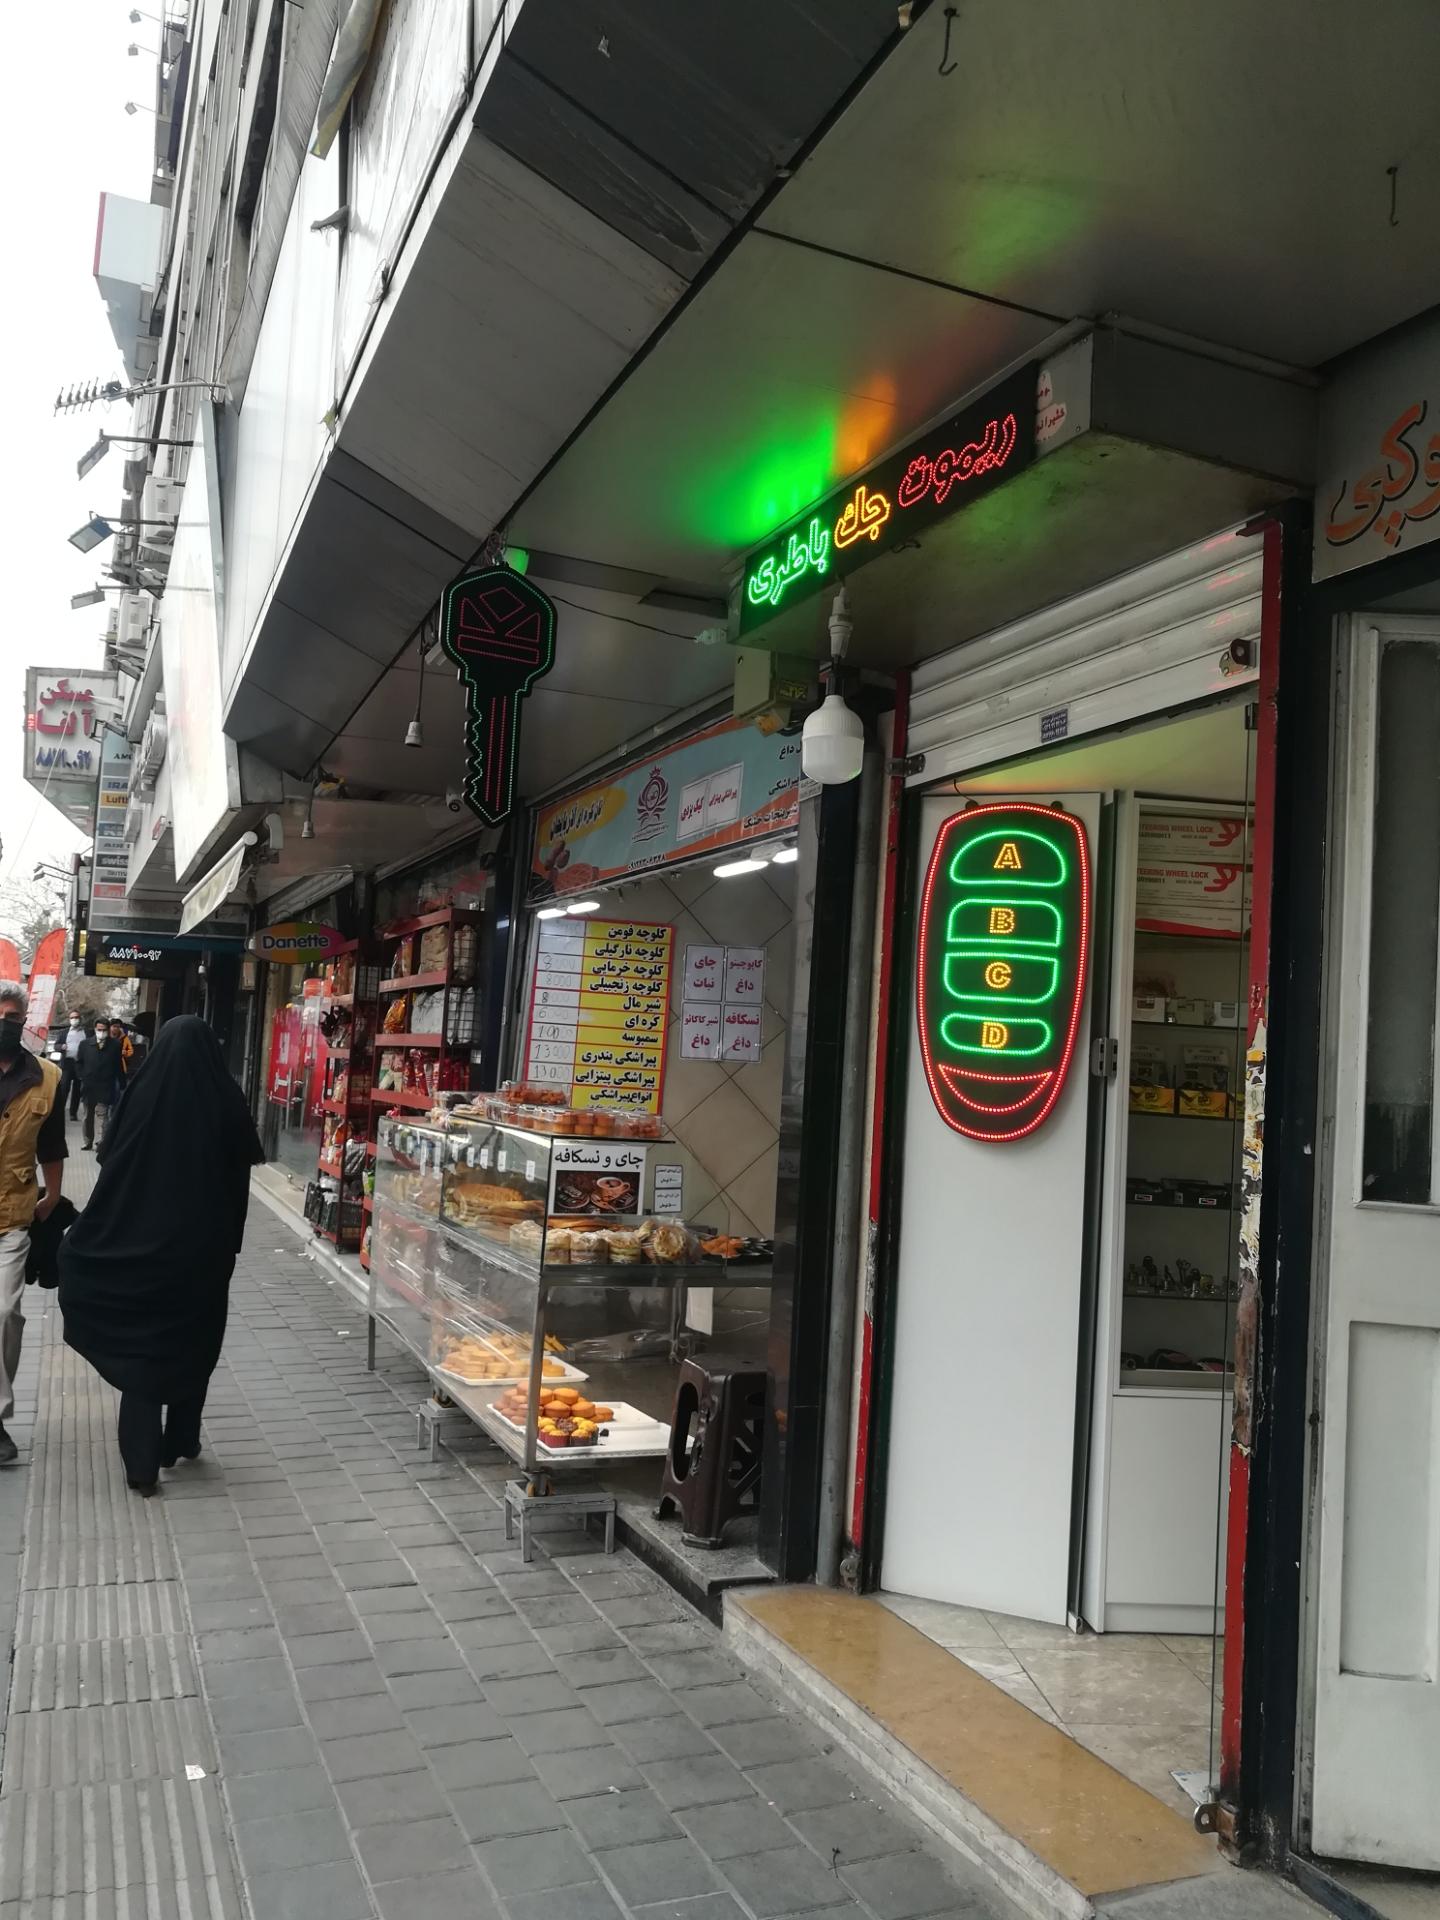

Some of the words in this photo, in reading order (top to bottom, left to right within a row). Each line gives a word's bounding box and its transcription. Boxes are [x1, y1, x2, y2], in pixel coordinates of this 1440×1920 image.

[899, 413, 1017, 508] ریموت
[748, 518, 829, 605] باطری
[36, 708, 96, 736] آلفا
[107, 782, 128, 790] IRA
[993, 843, 1022, 870] A
[1137, 867, 1164, 876] TEERING
[1166, 869, 1189, 877] WHEEL
[1191, 871, 1209, 879] LOCK
[989, 907, 1015, 934] B
[608, 925, 634, 939] فومن
[636, 928, 667, 942] کلوچه
[262, 935, 329, 950] Danette
[595, 942, 632, 959] نارگیلی
[634, 947, 665, 961] کلوچه
[592, 961, 631, 975] خرمایی
[633, 964, 664, 978] کلوچه
[984, 961, 1012, 988] C
[589, 977, 629, 993] زنجبیلی
[632, 981, 662, 995] کلوچه
[693, 977, 715, 991] نبات
[735, 979, 754, 994] داغ
[625, 1015, 639, 1028] ای
[641, 1015, 660, 1030] کره
[725, 1012, 760, 1025] نسکافه
[622, 1033, 659, 1046] سمبوسه
[691, 1033, 710, 1049] داغ
[981, 1021, 1008, 1049] D
[732, 1035, 751, 1051] داغ
[581, 1051, 613, 1064] بندری
[615, 1051, 657, 1068] پیراشکی
[575, 1069, 611, 1086] پیتزایی
[613, 1071, 655, 1088] پیراشکی
[554, 1147, 600, 1164] نسکافه
[602, 1156, 611, 1168] و
[615, 1152, 643, 1169] چای
